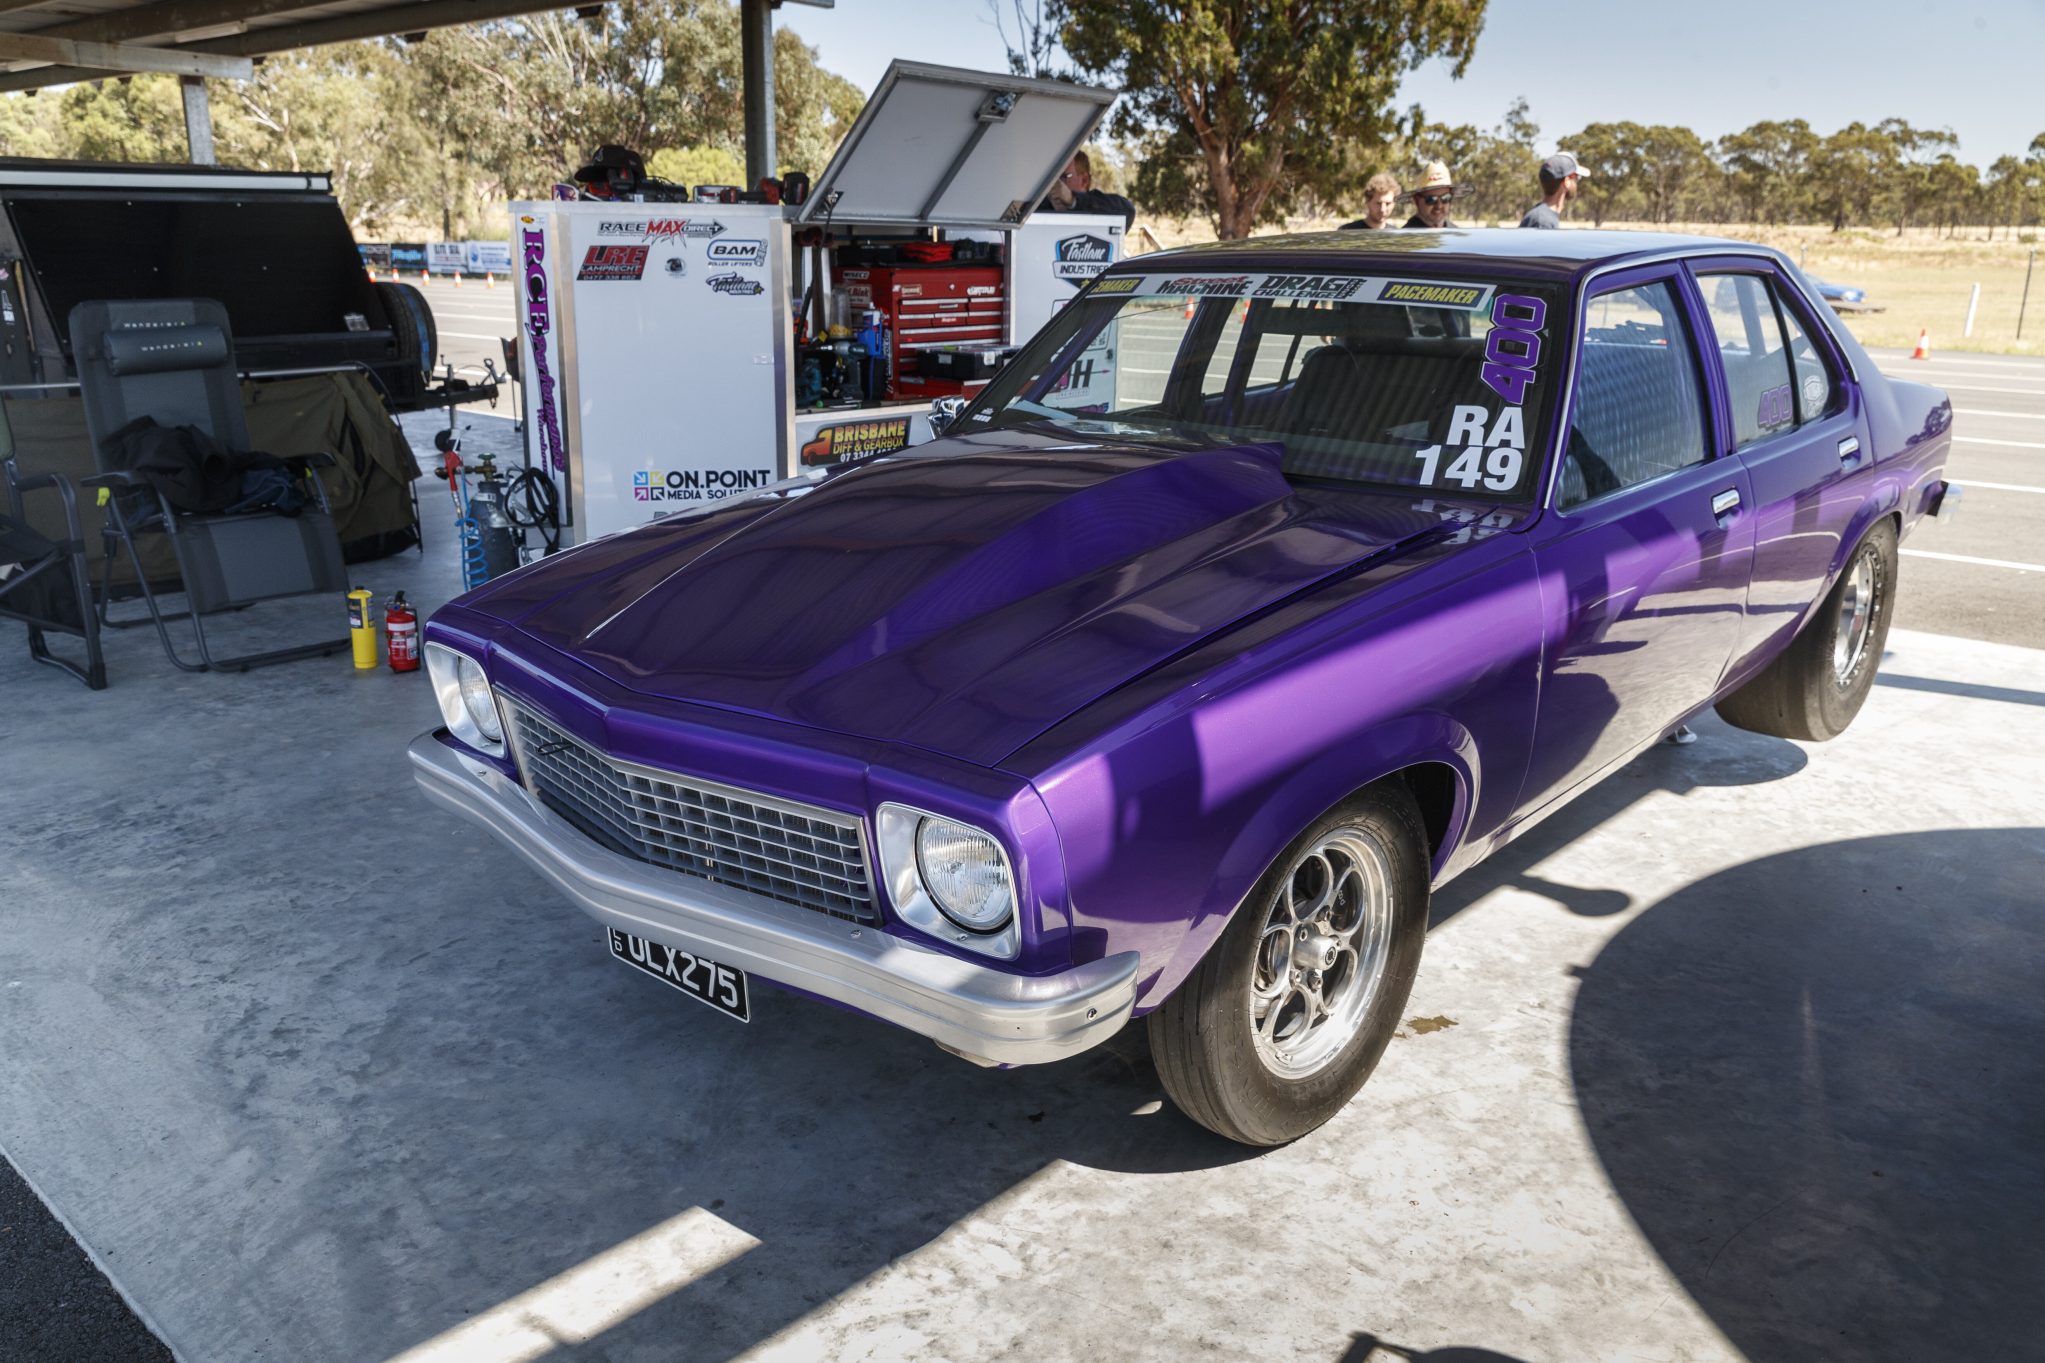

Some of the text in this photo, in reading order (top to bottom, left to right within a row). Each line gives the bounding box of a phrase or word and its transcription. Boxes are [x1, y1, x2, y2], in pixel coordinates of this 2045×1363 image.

[713, 245, 757, 255] BAM
[1061, 235, 1106, 261] Fastlane
[1155, 280, 1254, 295] MACHINE
[1259, 275, 1346, 290] DRAG
[1252, 288, 1337, 299] CHALLENGE
[1385, 283, 1479, 305] PACEMAKER
[1480, 293, 1547, 405] 400
[1758, 384, 1793, 429] 400
[834, 420, 906, 443] BRISBANE
[1446, 404, 1525, 448] RA
[833, 442, 853, 455] DIFF
[854, 441, 863, 452] &
[864, 436, 904, 451] GEARBOX
[840, 453, 851, 463] 07
[1415, 444, 1523, 491] 149
[666, 469, 771, 489] ON.POINT
[667, 490, 702, 500] MEDIA
[627, 934, 738, 1008] ULX275
